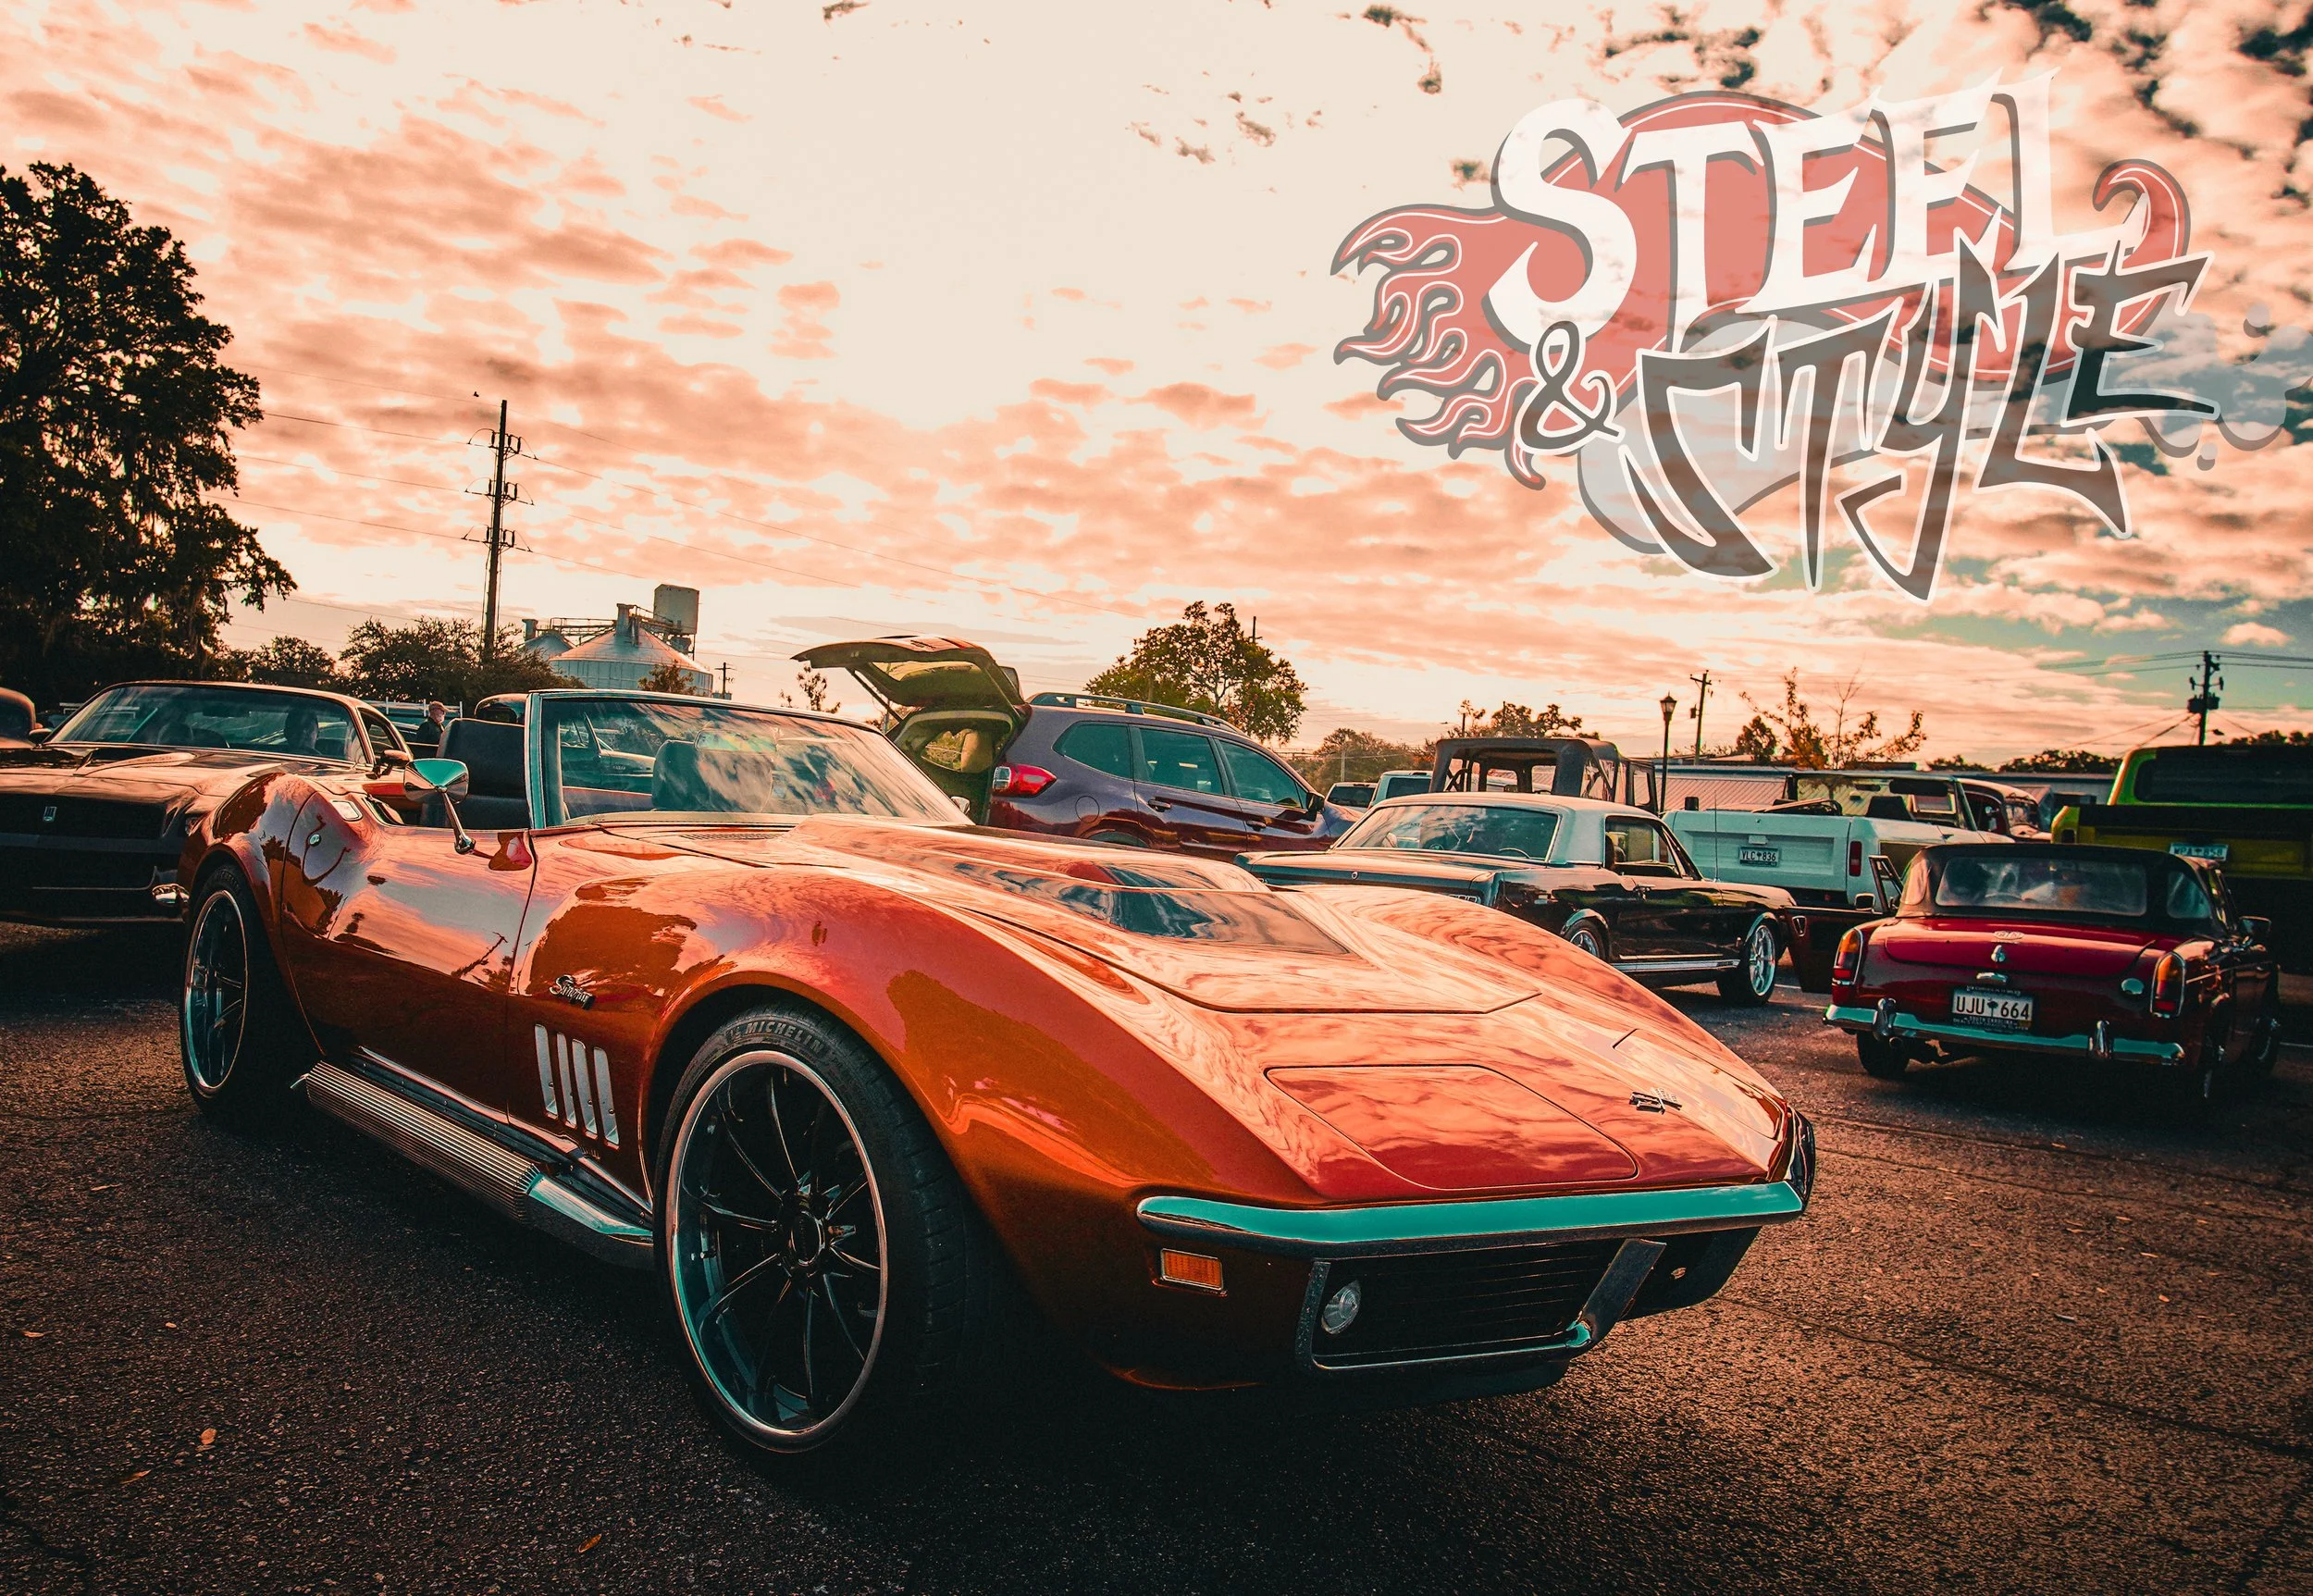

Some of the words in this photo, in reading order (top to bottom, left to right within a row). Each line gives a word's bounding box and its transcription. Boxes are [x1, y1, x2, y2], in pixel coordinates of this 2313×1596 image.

[1762, 851, 1776, 861] 836
[1956, 996, 1985, 1015] UJU
[2000, 1001, 2030, 1020] 664
[745, 1021, 823, 1054] MICHELIN
